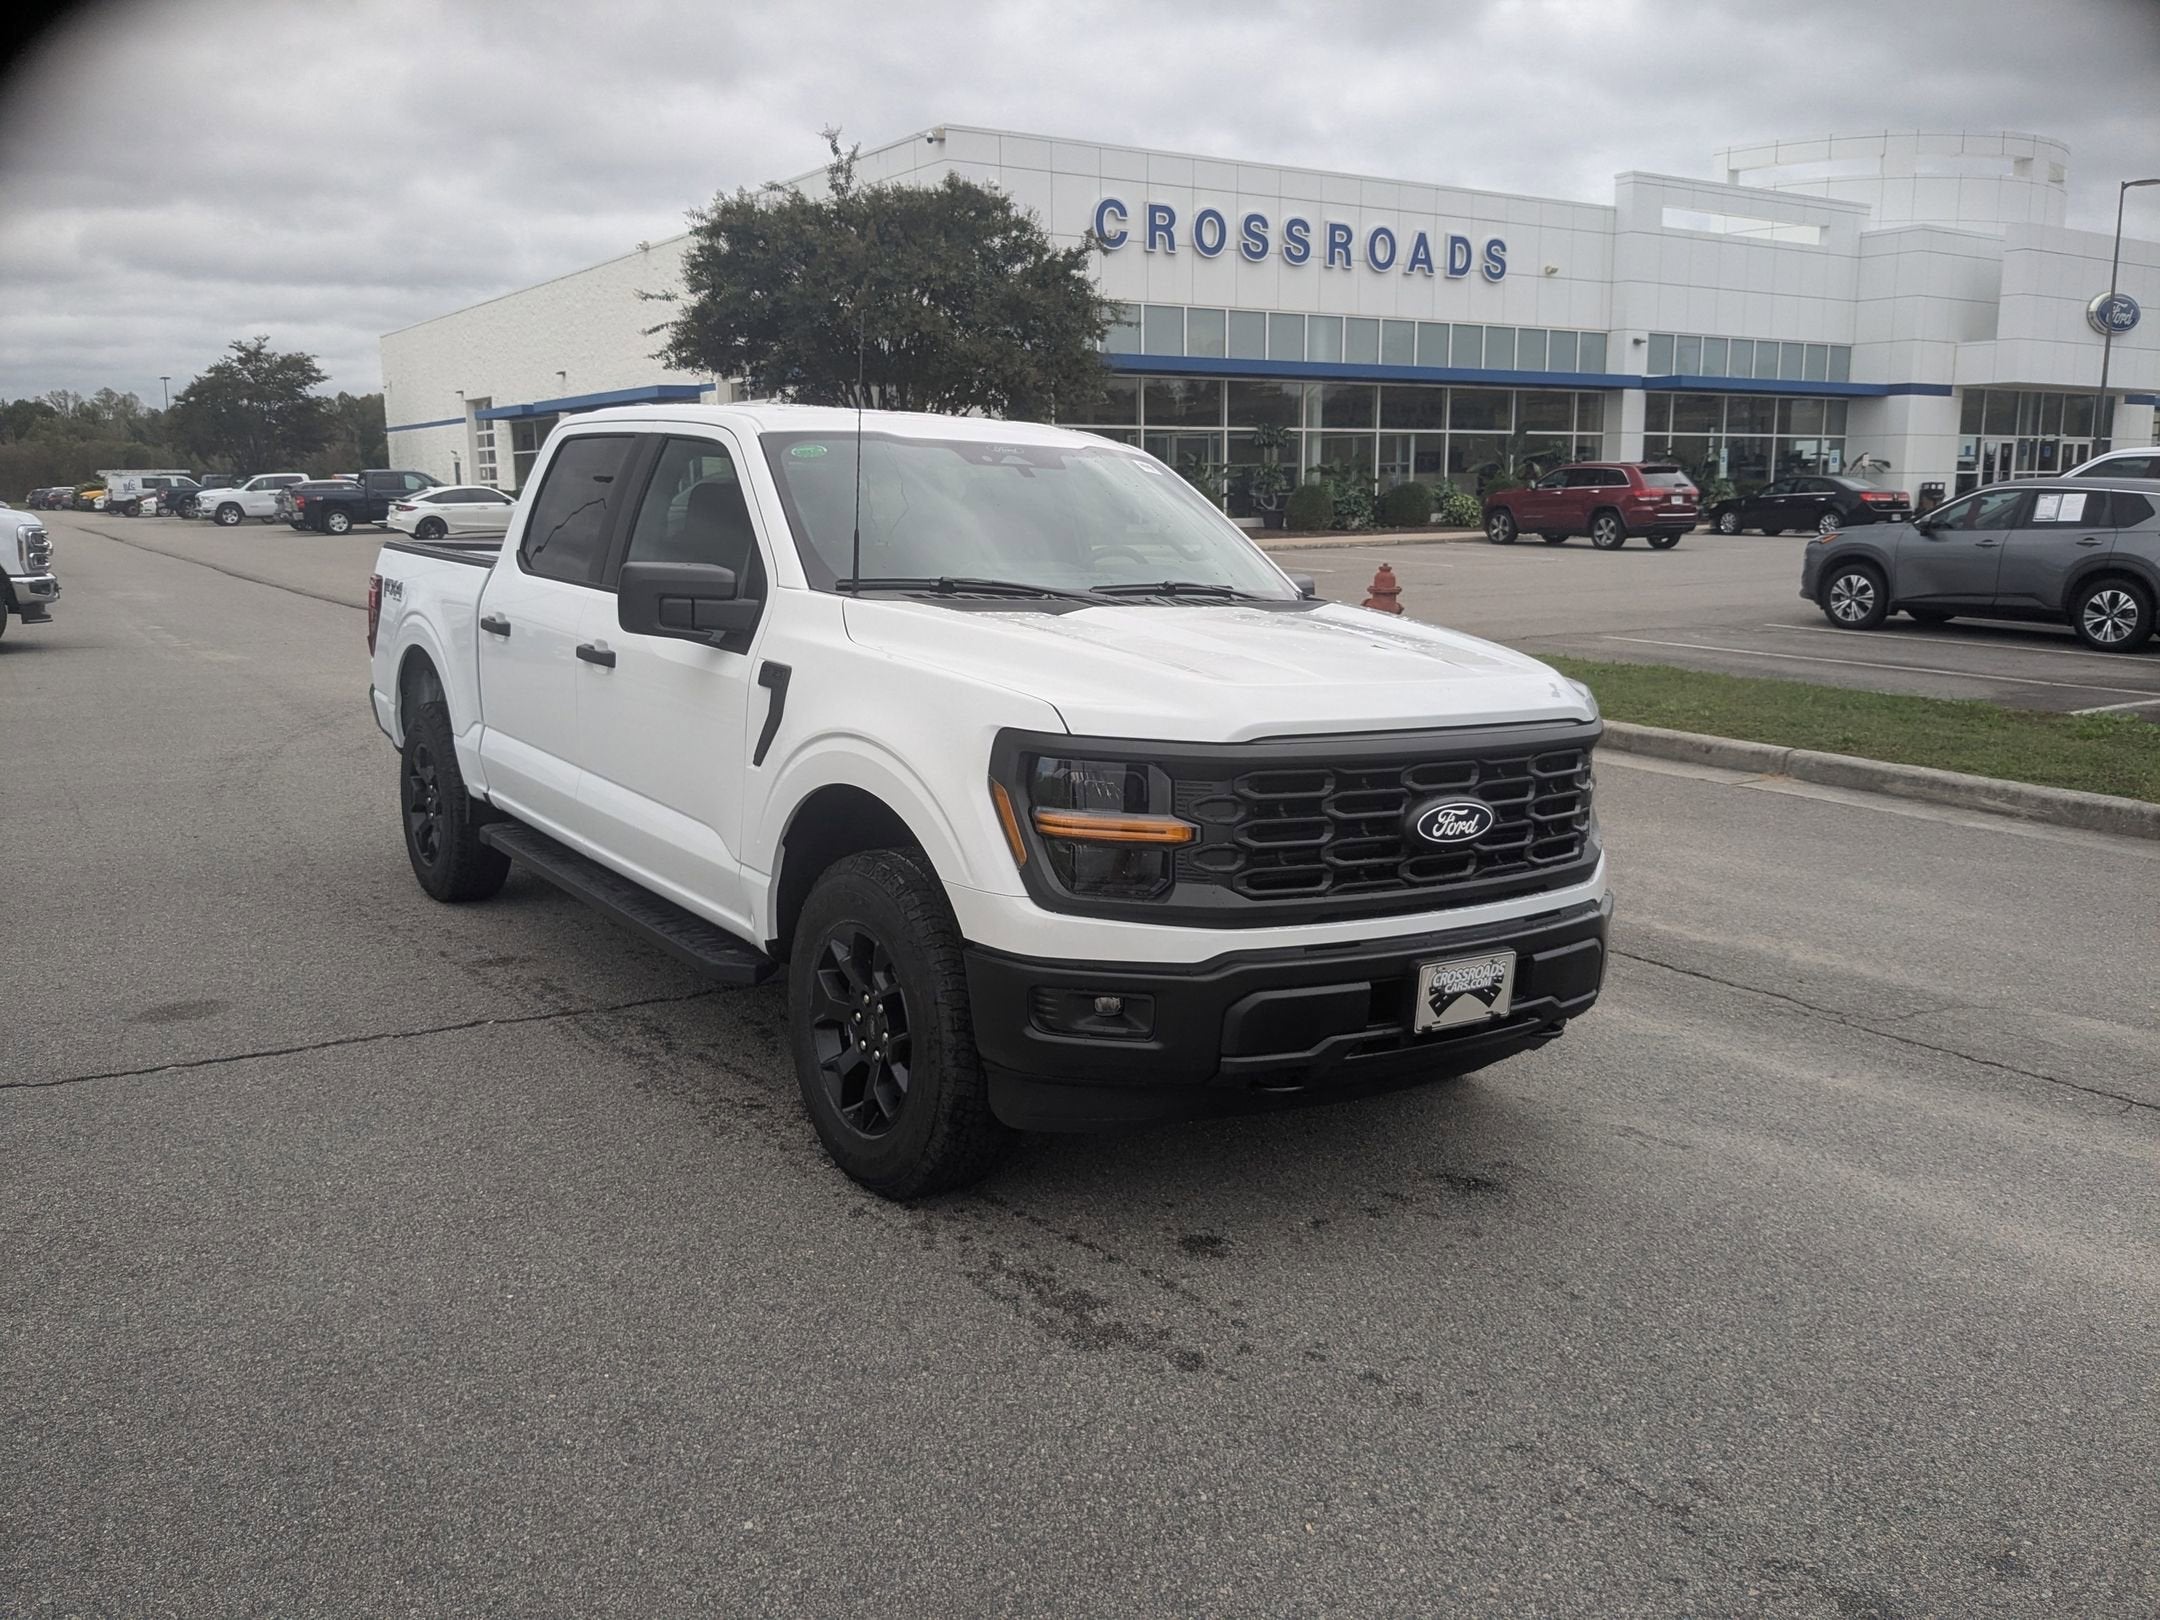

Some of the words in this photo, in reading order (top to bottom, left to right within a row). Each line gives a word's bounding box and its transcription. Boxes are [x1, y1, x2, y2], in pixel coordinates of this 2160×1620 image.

[1094, 197, 1508, 283] CROSSROADS
[2105, 301, 2134, 325] Ford
[1432, 809, 1479, 837] Ford
[1432, 962, 1506, 987] CROSSROADS
[1444, 976, 1492, 993] CARS.COM
